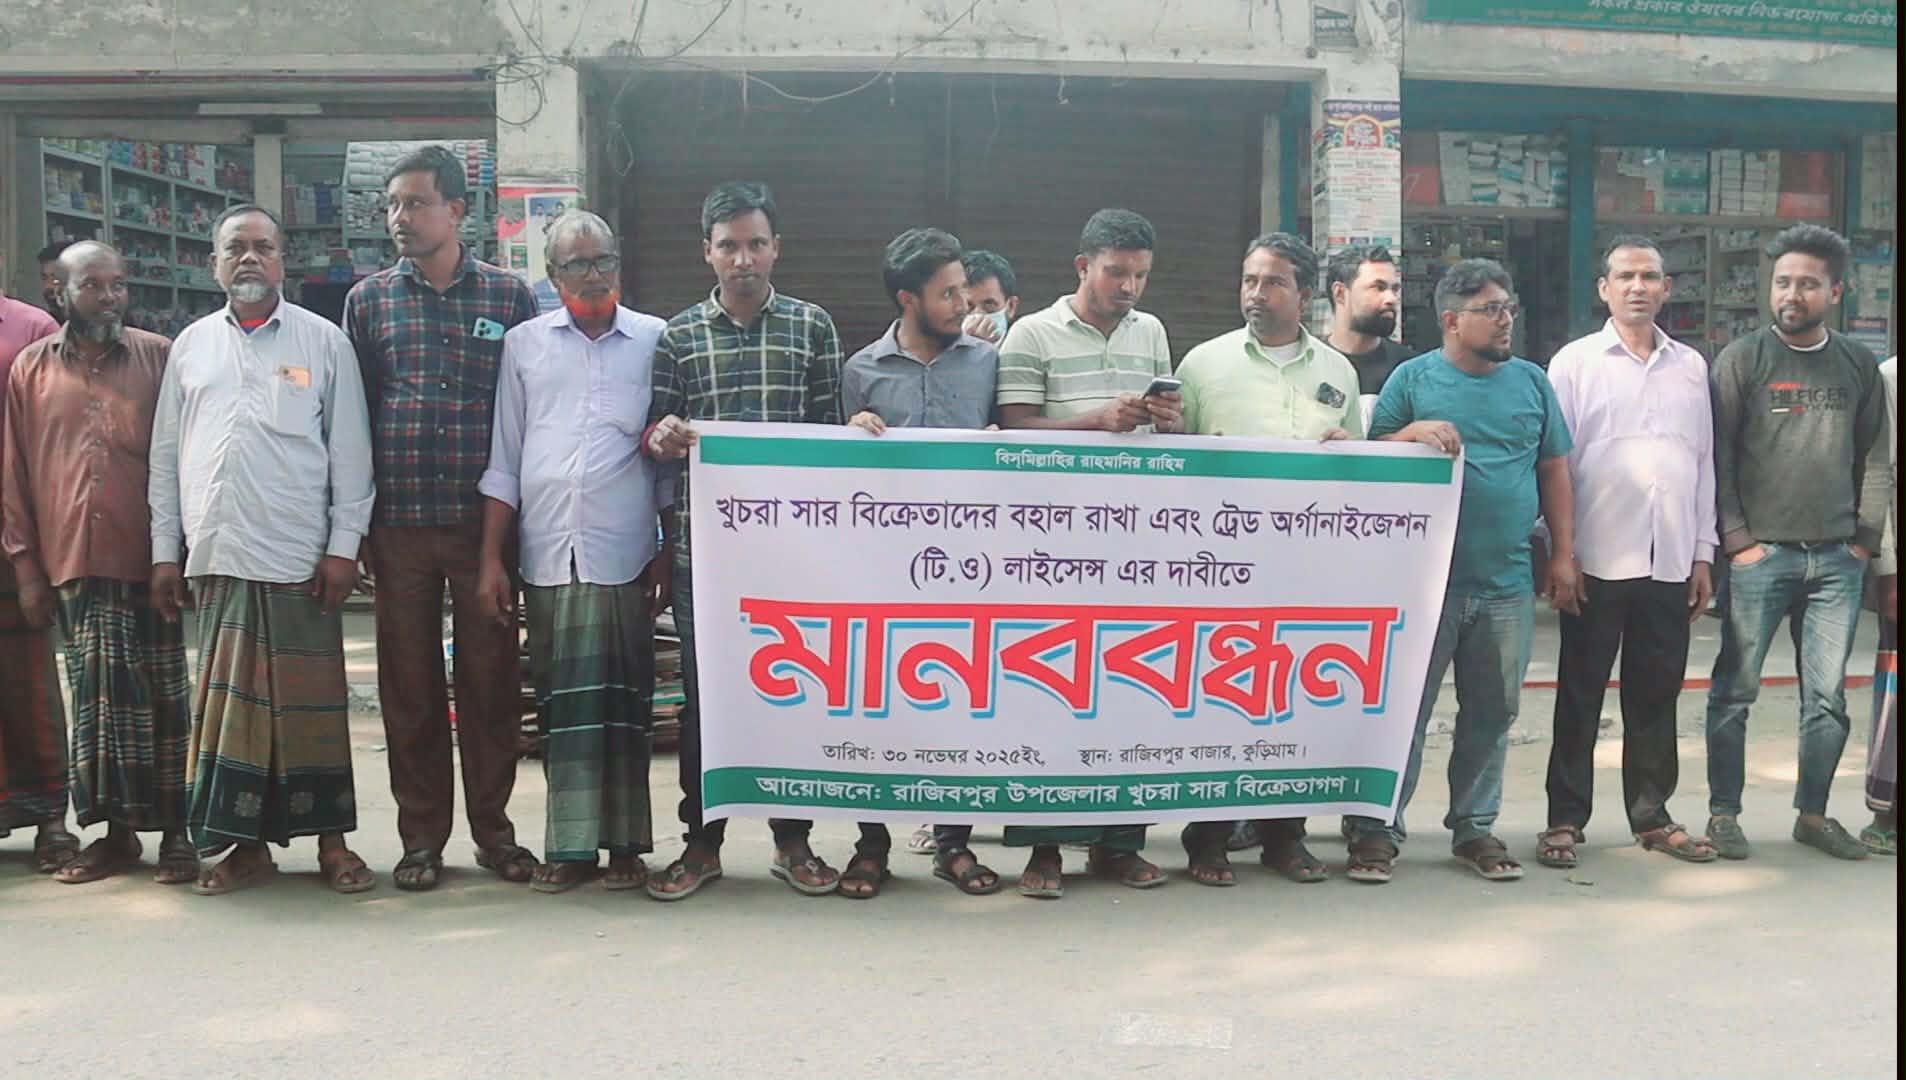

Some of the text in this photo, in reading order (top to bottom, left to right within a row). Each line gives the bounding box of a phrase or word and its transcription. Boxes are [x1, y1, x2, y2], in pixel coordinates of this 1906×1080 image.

[1080, 451, 1143, 470] রাহমানির
[1147, 453, 1186, 472] রাহিম
[715, 491, 1431, 541] খুচরা সার বিক্রেতাদের বহাল রাখা এবং ট্রেড অর্গানাইজেশন
[1002, 549, 1108, 587] লাইসেন্স
[1117, 559, 1158, 587] এর
[1166, 550, 1256, 588] দাবীতে
[741, 597, 1404, 724] মানববন্ধন
[822, 741, 876, 762] তারিখ:
[882, 749, 908, 763] ৩০
[914, 749, 969, 765] নভেম্বর
[1119, 744, 1185, 766] রাজিবপুর
[892, 779, 998, 808] রাজিবপুর
[1006, 780, 1120, 804] উপজেলার
[1127, 781, 1182, 807] খুচরা
[1188, 780, 1230, 800] সার
